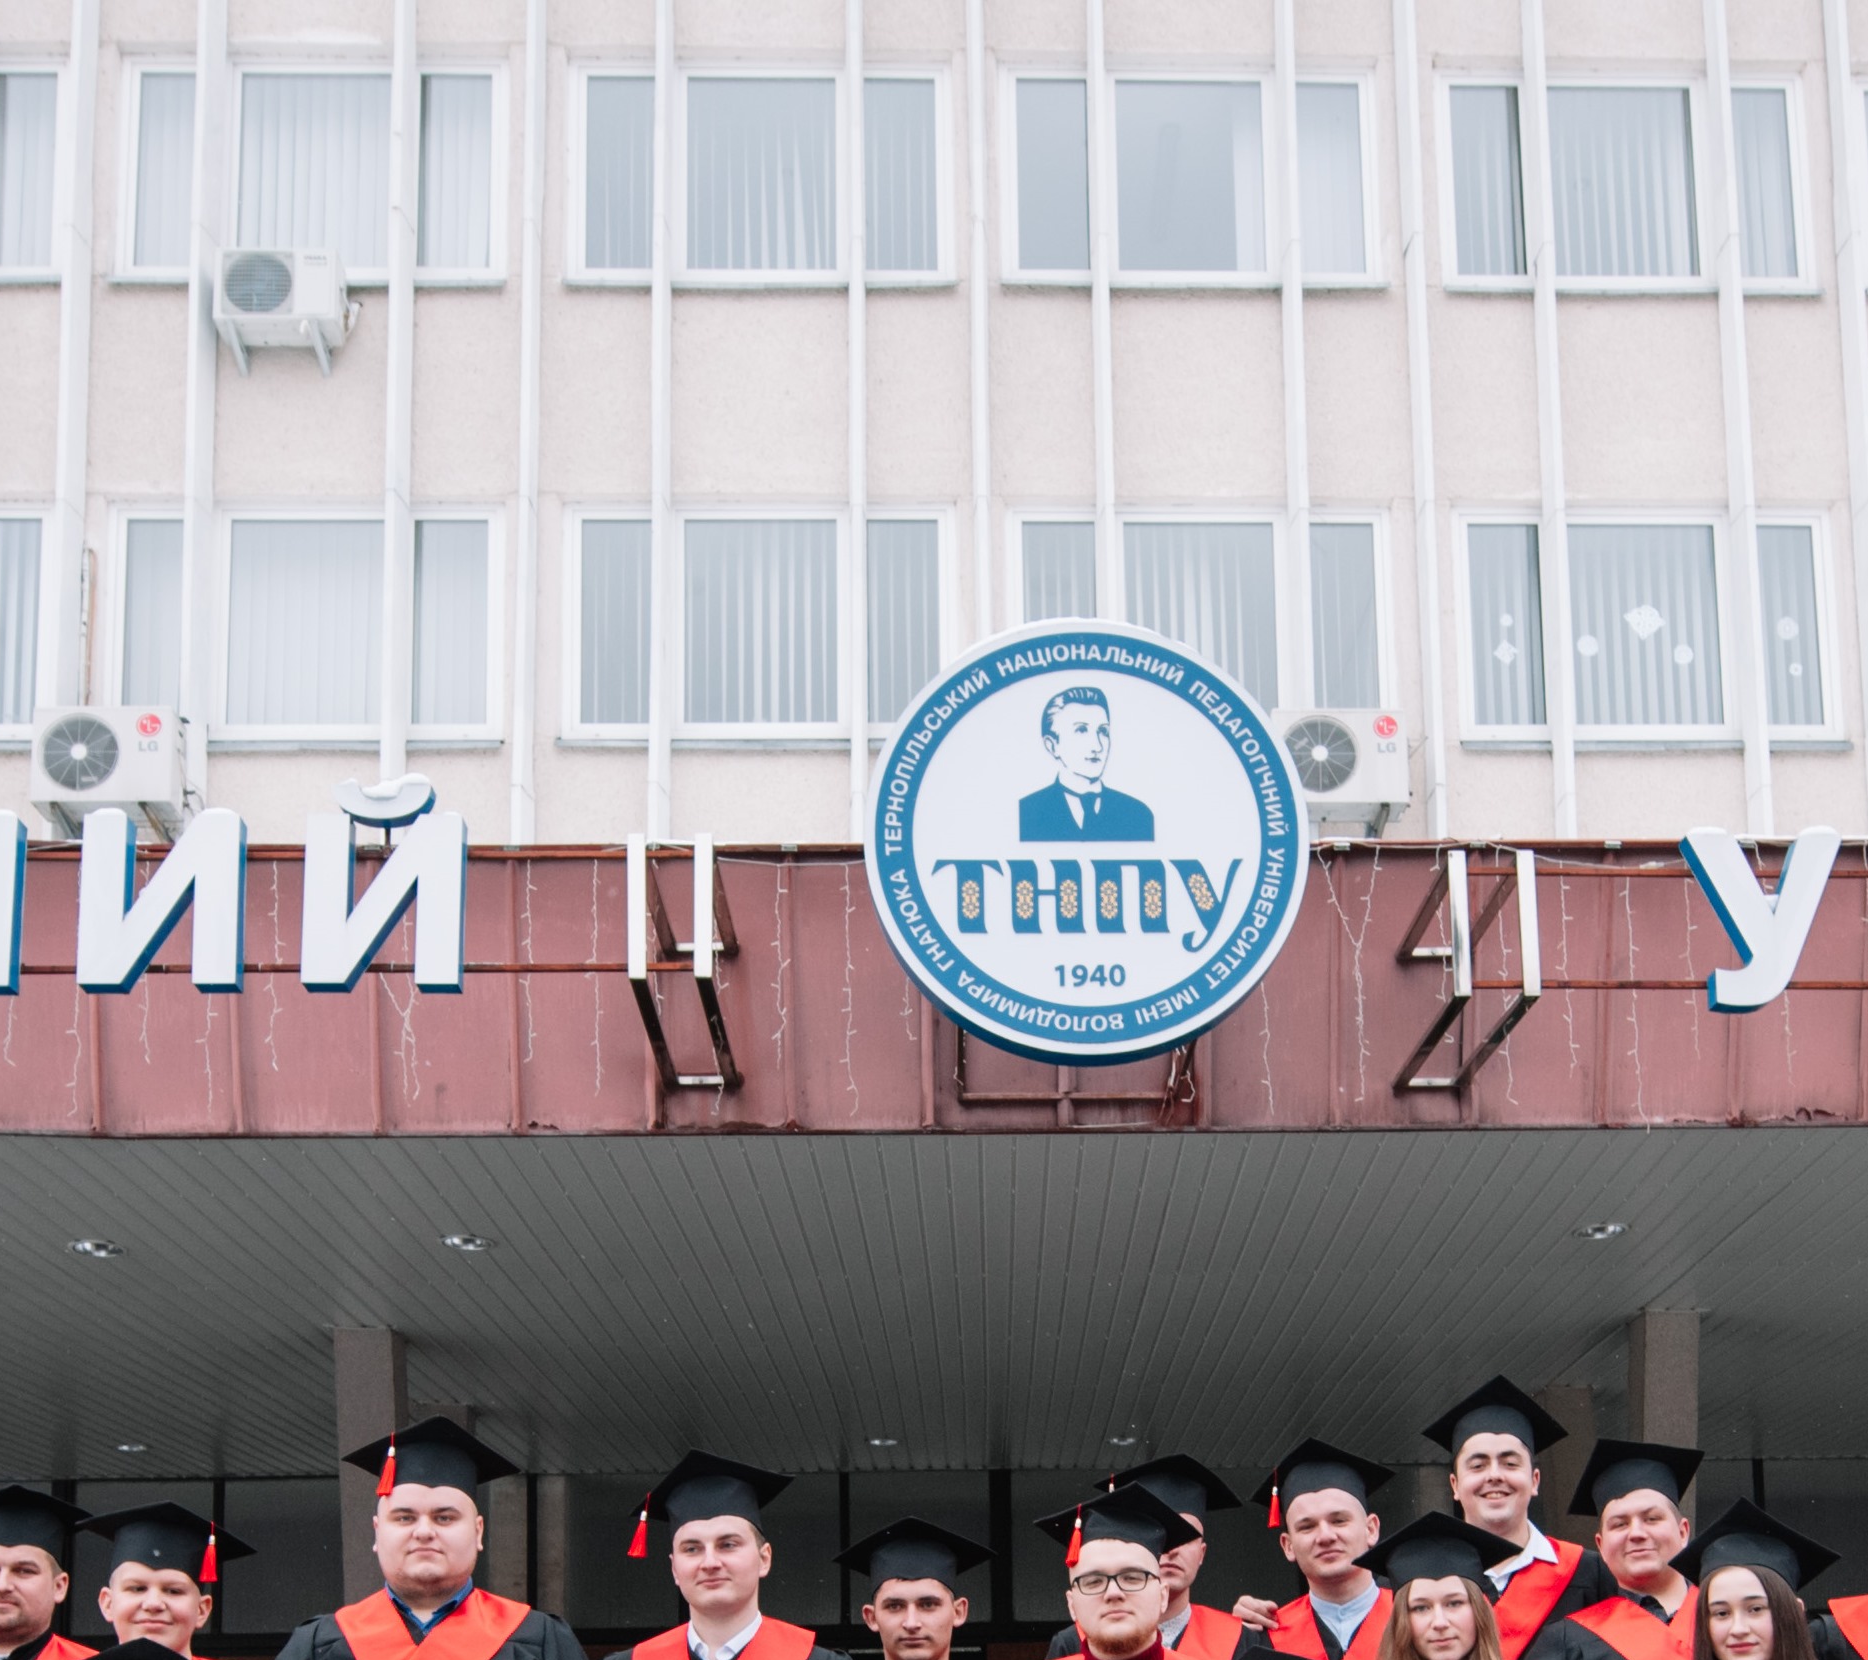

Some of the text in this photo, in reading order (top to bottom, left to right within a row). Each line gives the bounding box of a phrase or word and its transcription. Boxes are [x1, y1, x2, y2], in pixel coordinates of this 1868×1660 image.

[138, 740, 159, 752] LG
[1377, 742, 1397, 753] LG
[884, 644, 1291, 1033] ТЕРНОПІЛЬСЬКИЙ НАЦІОНАЛЬНИЙ ПЕДАГОГІЧНИЙ УНІВЕРСИТЕТ ІМЕНІ ВОЛОДИМИРА ГНАТЮКА
[931, 859, 1243, 953] ТНПУ
[1054, 964, 1127, 988] 1940
